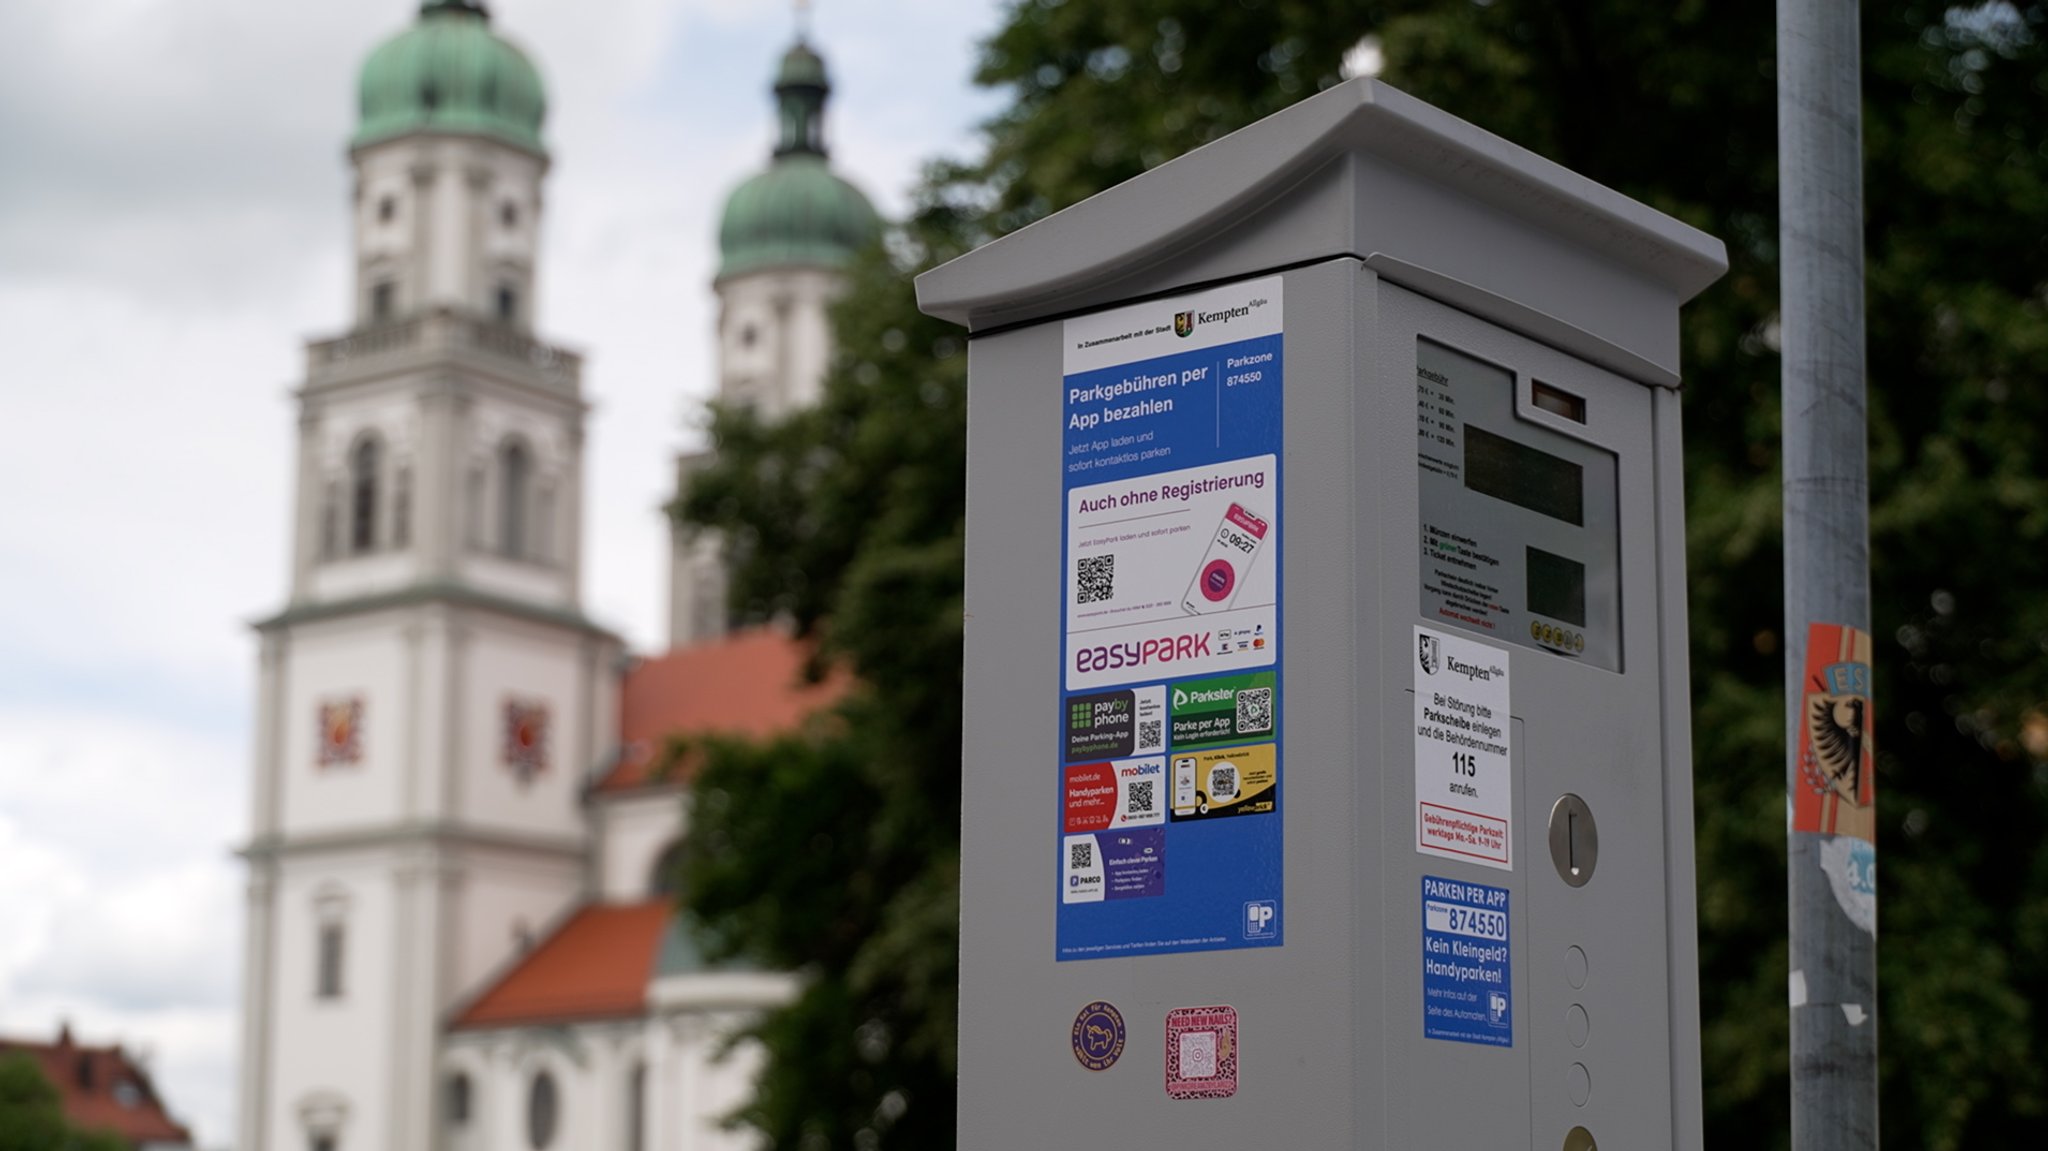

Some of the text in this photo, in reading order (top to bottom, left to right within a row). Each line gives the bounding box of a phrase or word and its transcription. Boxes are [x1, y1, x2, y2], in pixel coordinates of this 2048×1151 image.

[1198, 299, 1268, 324] Kempten Allgäu
[1085, 332, 1132, 348] Zusammenarbeit
[1134, 330, 1143, 338] mit
[1144, 328, 1154, 336] der
[1156, 325, 1171, 333] Stadt
[1227, 352, 1273, 369] Parkzone
[1070, 366, 1208, 405] Parkgebühren per
[1226, 371, 1262, 387] 874550
[1416, 365, 1449, 385] arkgebühr
[1069, 398, 1173, 431] App bezahlen
[1069, 431, 1154, 455] Jetzt App laden und
[1068, 446, 1171, 472] sofort kontaktlos parken
[1078, 471, 1264, 514] Auch ohne Registrierung
[1229, 533, 1255, 554] 09:27
[1430, 525, 1450, 538] Münzen
[1451, 532, 1477, 548] einwerfen
[1429, 548, 1447, 561] Ticket
[1447, 556, 1477, 570] entnehmen
[1430, 537, 1438, 547] Mit
[1457, 545, 1471, 557] Taste
[1472, 551, 1499, 566] bestätigen
[1440, 607, 1459, 619] Automat
[1459, 614, 1481, 625] wechselt
[1447, 656, 1490, 681] Kempten
[1190, 688, 1235, 704] Parkster
[1434, 692, 1492, 719] Bei Störung bitte
[1094, 713, 1129, 729] phone
[1173, 717, 1231, 732] Parke per App
[1424, 706, 1502, 739] Parkscheibe einlegen
[1071, 731, 1129, 744] Deine Parking-App
[1417, 725, 1508, 756] und die Behördennummer
[1121, 763, 1160, 777] mobilet
[1452, 751, 1476, 777] 115
[1069, 773, 1101, 783] mobilet.de
[1069, 785, 1115, 799] Handyparken
[1449, 782, 1479, 798] anrufen.
[1424, 812, 1478, 834] Gebührenpflichtige
[1427, 828, 1454, 841] werktags
[1490, 839, 1502, 850] Uhr
[1079, 876, 1101, 884] PARCO
[1425, 879, 1506, 907] PARKEN PER APP
[1427, 904, 1448, 913] Parkzone
[1449, 908, 1505, 937] 874550
[1425, 936, 1507, 963] Kein Kleingeld?
[1426, 958, 1502, 983] Handyparken!
[1427, 987, 1478, 1002] Mehr Infos auf der
[1171, 1014, 1232, 1027] NEED NEW NAILS?
[1427, 1004, 1441, 1016] Seite
[1442, 1008, 1454, 1018] des
